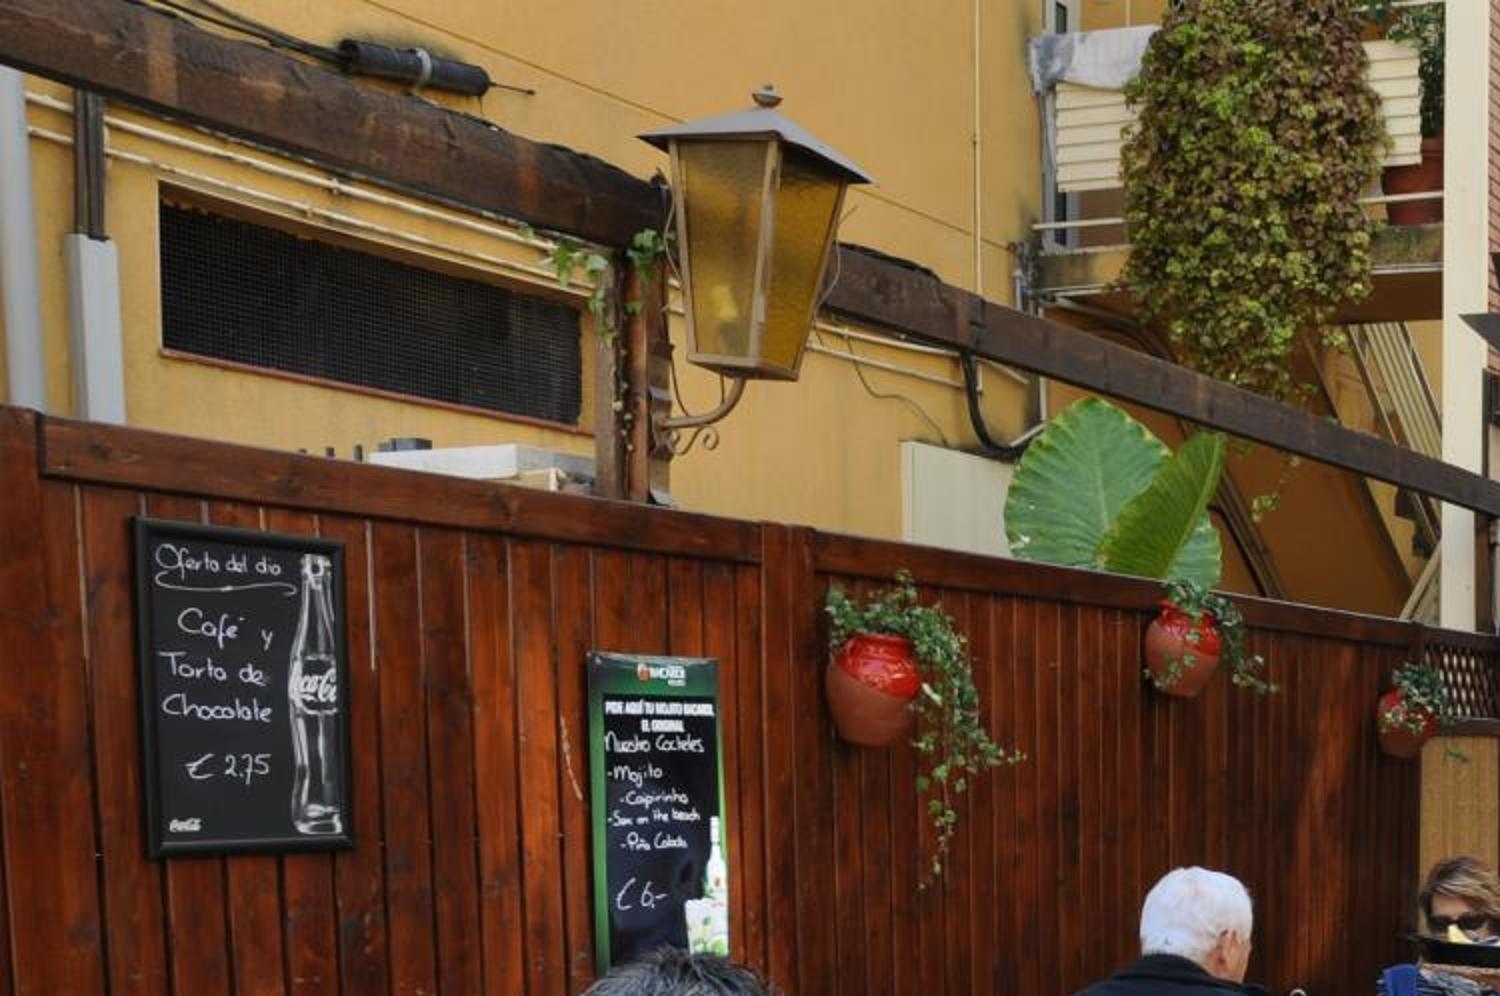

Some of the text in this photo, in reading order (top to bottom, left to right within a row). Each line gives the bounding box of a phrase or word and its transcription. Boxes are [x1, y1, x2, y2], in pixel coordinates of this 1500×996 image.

[155, 543, 219, 581] Oferta
[225, 553, 248, 573] del
[177, 607, 273, 650] Café y
[159, 650, 269, 687] Torta de
[162, 693, 273, 723] Chocolate
[184, 753, 215, 779] €
